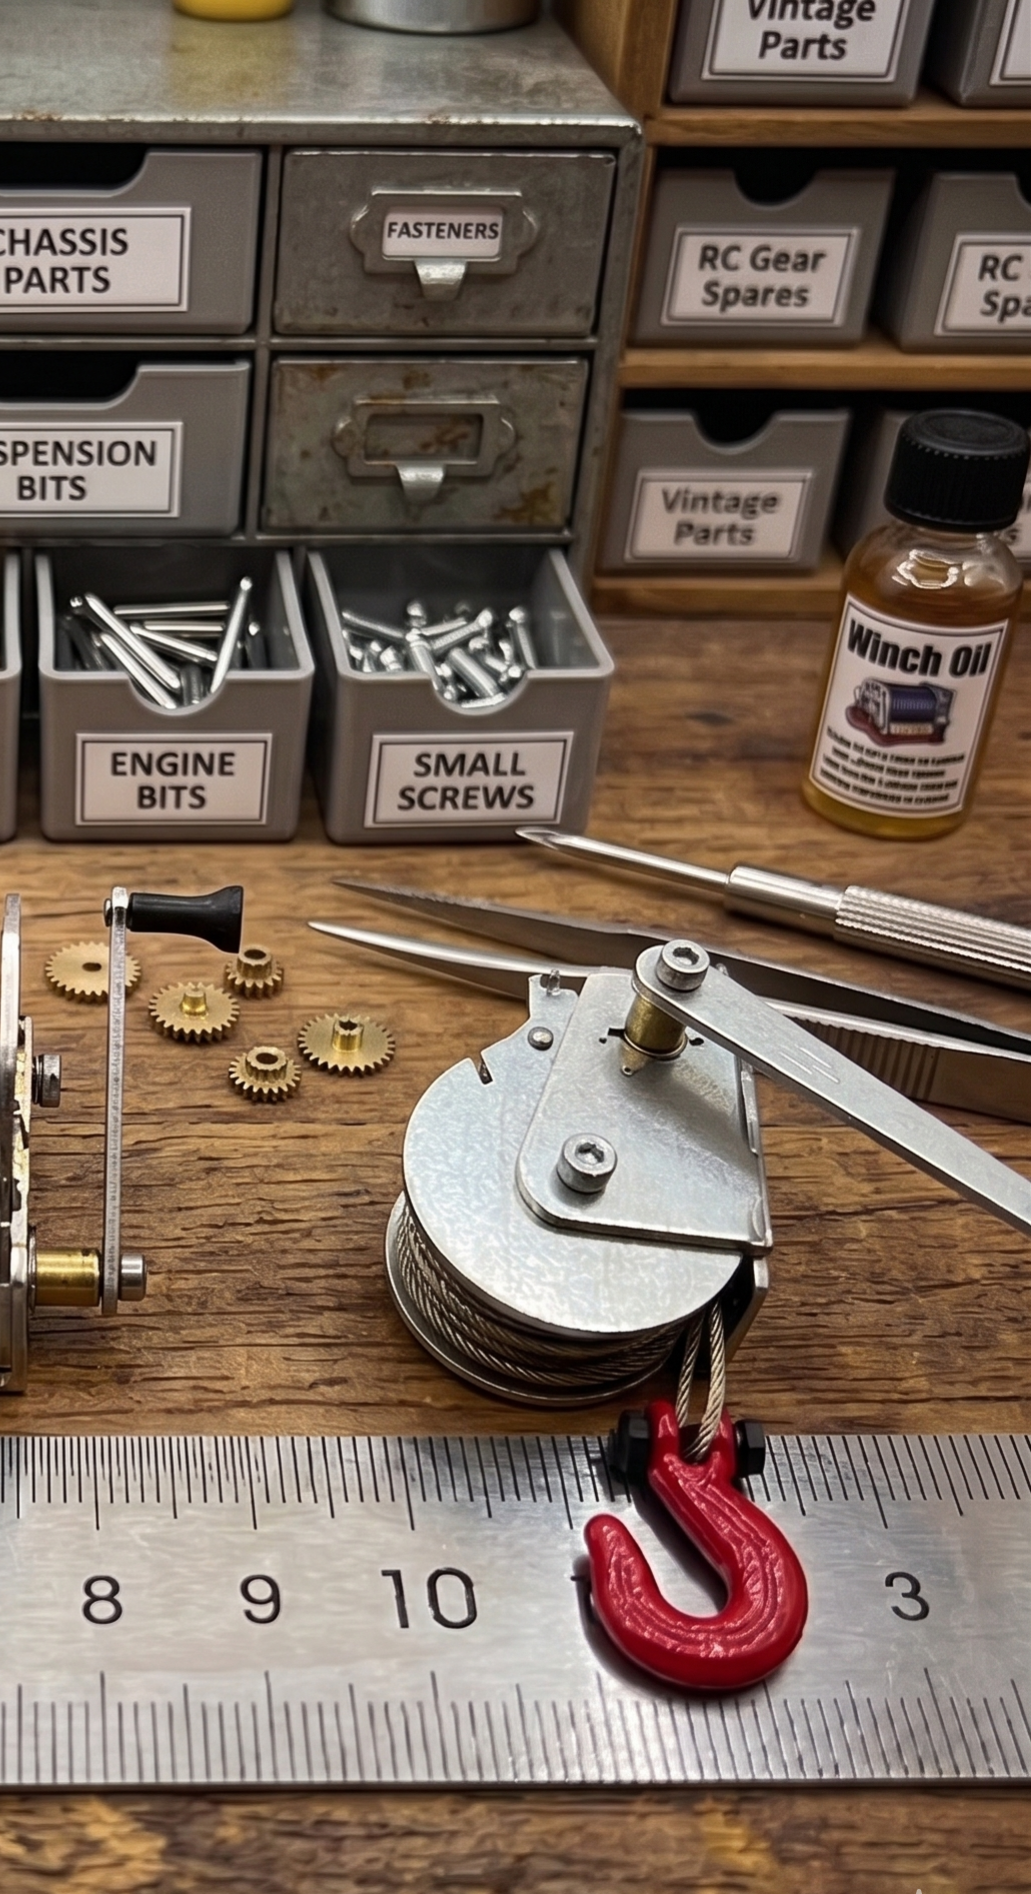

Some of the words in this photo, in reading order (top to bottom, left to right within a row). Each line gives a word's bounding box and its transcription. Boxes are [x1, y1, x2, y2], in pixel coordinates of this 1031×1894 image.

[748, 0, 877, 30] Vintage
[758, 31, 848, 60] Parts
[385, 220, 501, 242] FASTENERS
[698, 243, 742, 272] RC
[749, 244, 827, 273] Gear
[978, 253, 1024, 282] RC
[4, 265, 111, 294] PARTS
[702, 279, 809, 313] Spares
[17, 475, 87, 501] BITS
[661, 487, 781, 515] Vintage
[674, 521, 755, 547] Parts
[846, 618, 943, 677] Winch
[949, 642, 992, 679] Oil
[111, 751, 236, 777] ENGINE
[413, 752, 526, 778] SMALL
[137, 784, 207, 810] BITS
[397, 784, 535, 811] SCREWS
[82, 1575, 123, 1625] 8
[240, 1574, 281, 1625] 9
[381, 1567, 478, 1630] 10
[884, 1571, 930, 1622] 3
